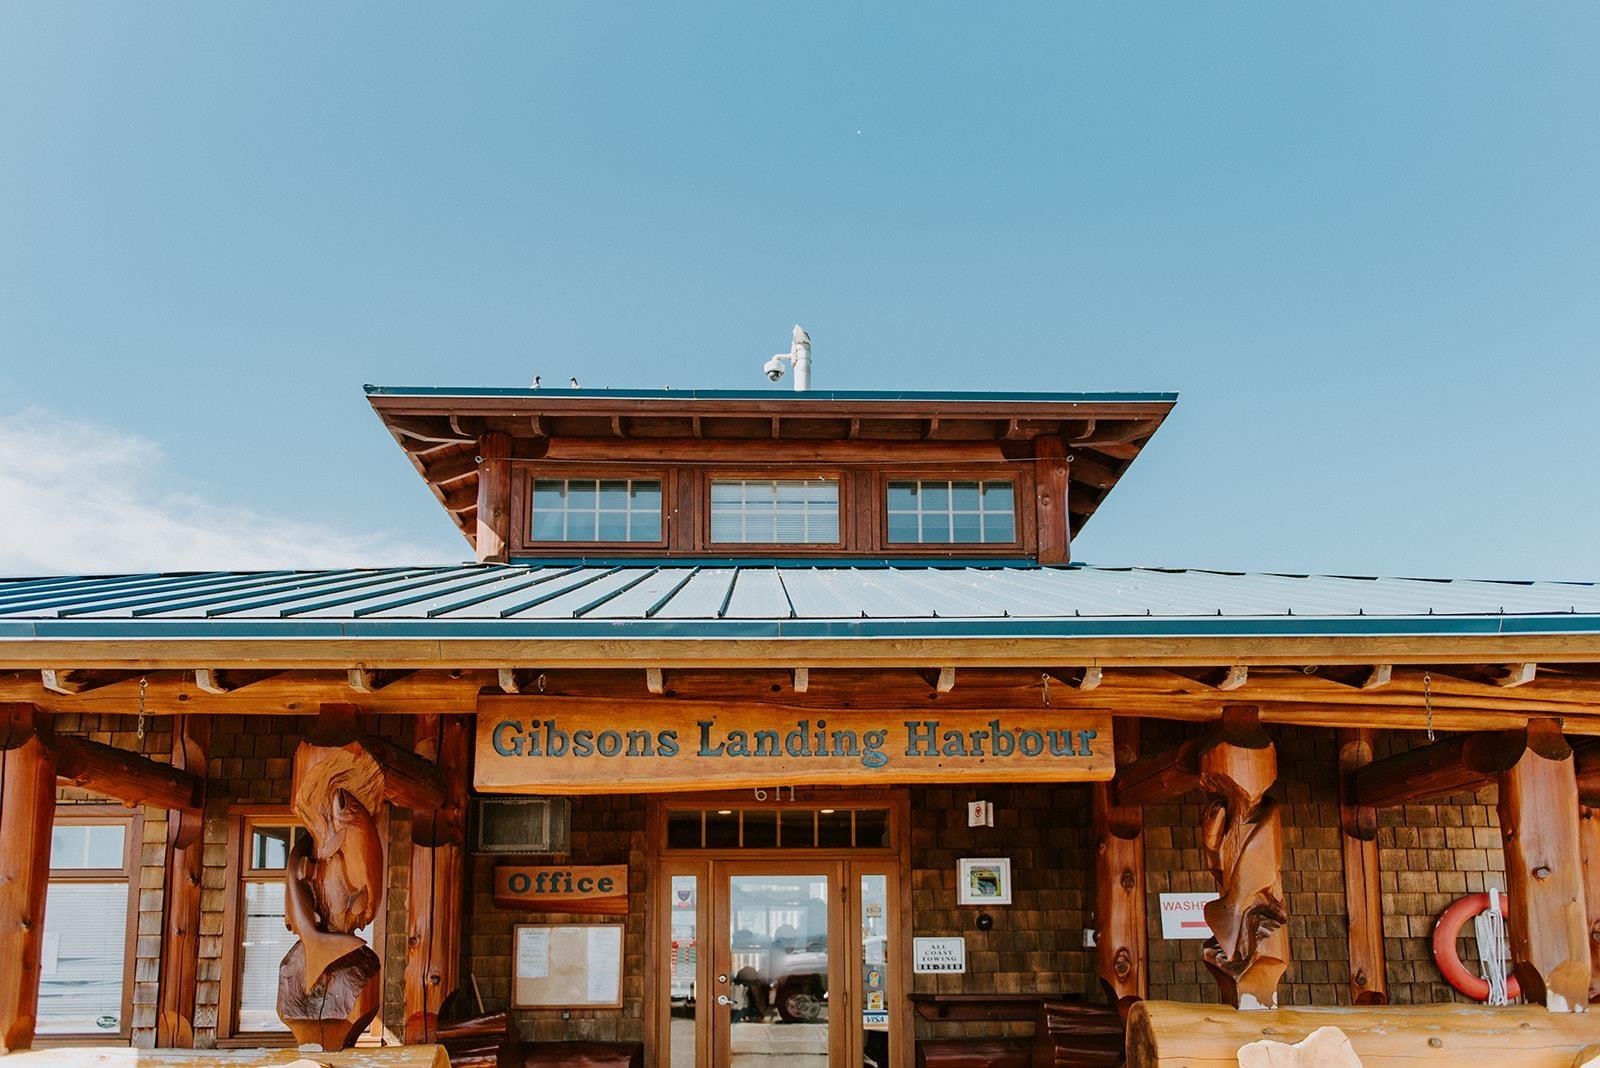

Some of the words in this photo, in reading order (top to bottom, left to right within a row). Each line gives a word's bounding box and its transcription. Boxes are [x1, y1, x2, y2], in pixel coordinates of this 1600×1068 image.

[492, 718, 680, 758] Gibsons
[697, 719, 889, 769] Landing
[904, 719, 1098, 757] Harbour
[508, 870, 614, 894] Office
